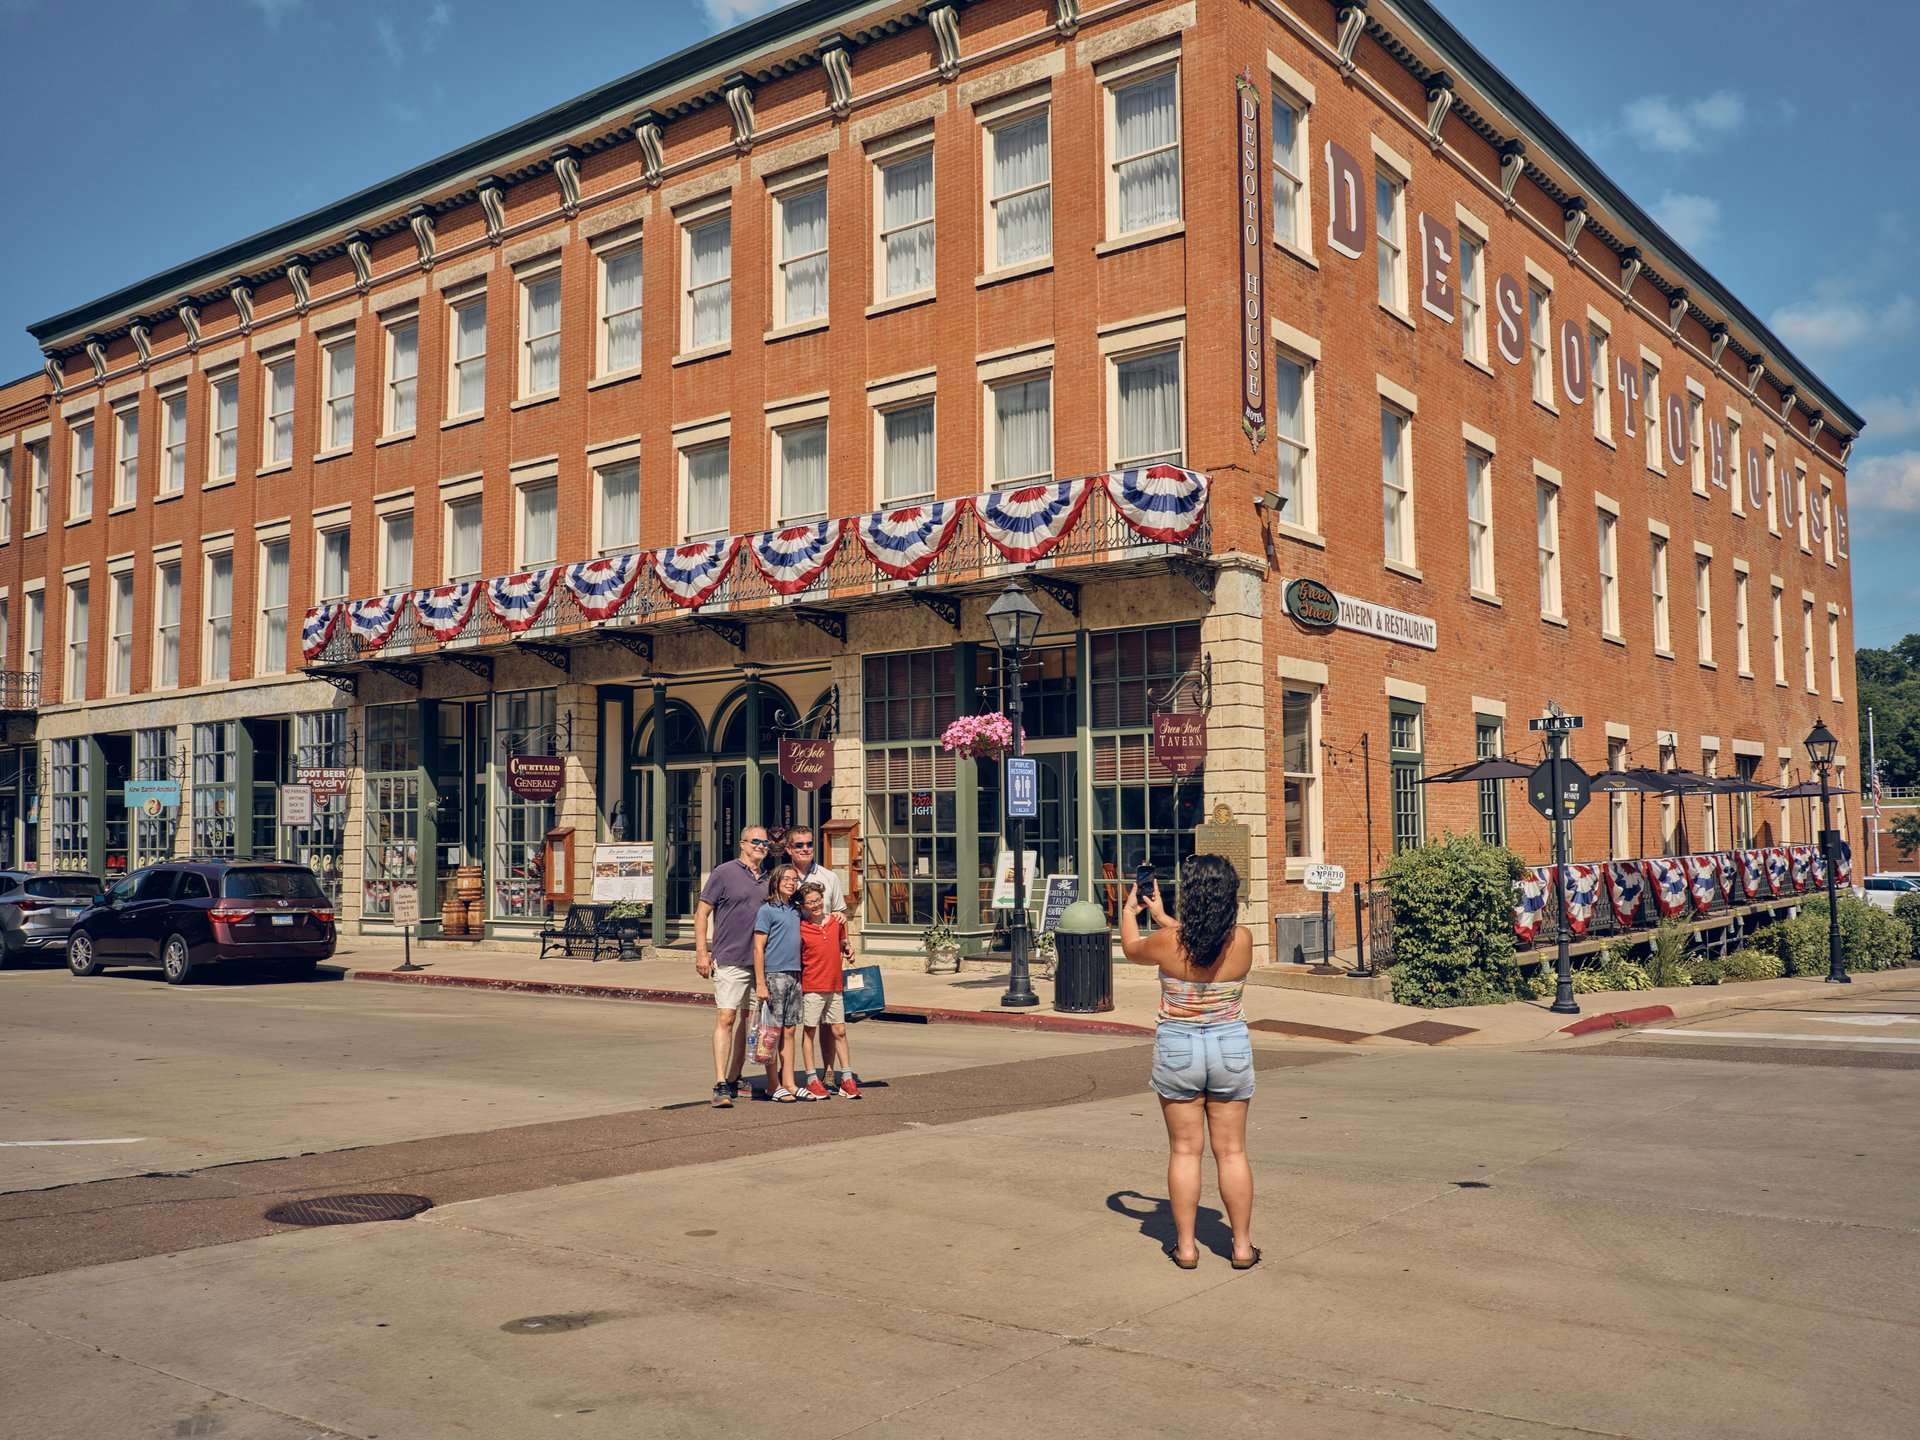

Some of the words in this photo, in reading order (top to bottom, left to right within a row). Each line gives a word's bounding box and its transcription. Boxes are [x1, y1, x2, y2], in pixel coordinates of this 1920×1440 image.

[1241, 98, 1259, 246] DESOTO
[1245, 272, 1262, 398] HOUSE
[1325, 139, 1687, 467] DESOTO
[1708, 417, 1848, 559] HOUSE
[1245, 405, 1264, 423] HOTEL
[1298, 581, 1332, 605] Green
[1298, 601, 1334, 622] Street
[1340, 601, 1373, 629] TAVERN
[1376, 611, 1382, 630] &
[1384, 613, 1434, 643] RESTAURANT
[1160, 718, 1180, 735] Green
[1181, 718, 1202, 734] Street
[1537, 719, 1560, 730] MAIN
[1160, 735, 1203, 747] TAVERN
[296, 770, 321, 778] ROOT
[322, 770, 346, 778] BEER
[791, 757, 824, 774] House
[308, 778, 346, 790] revelry
[1322, 870, 1344, 879] PATIO
